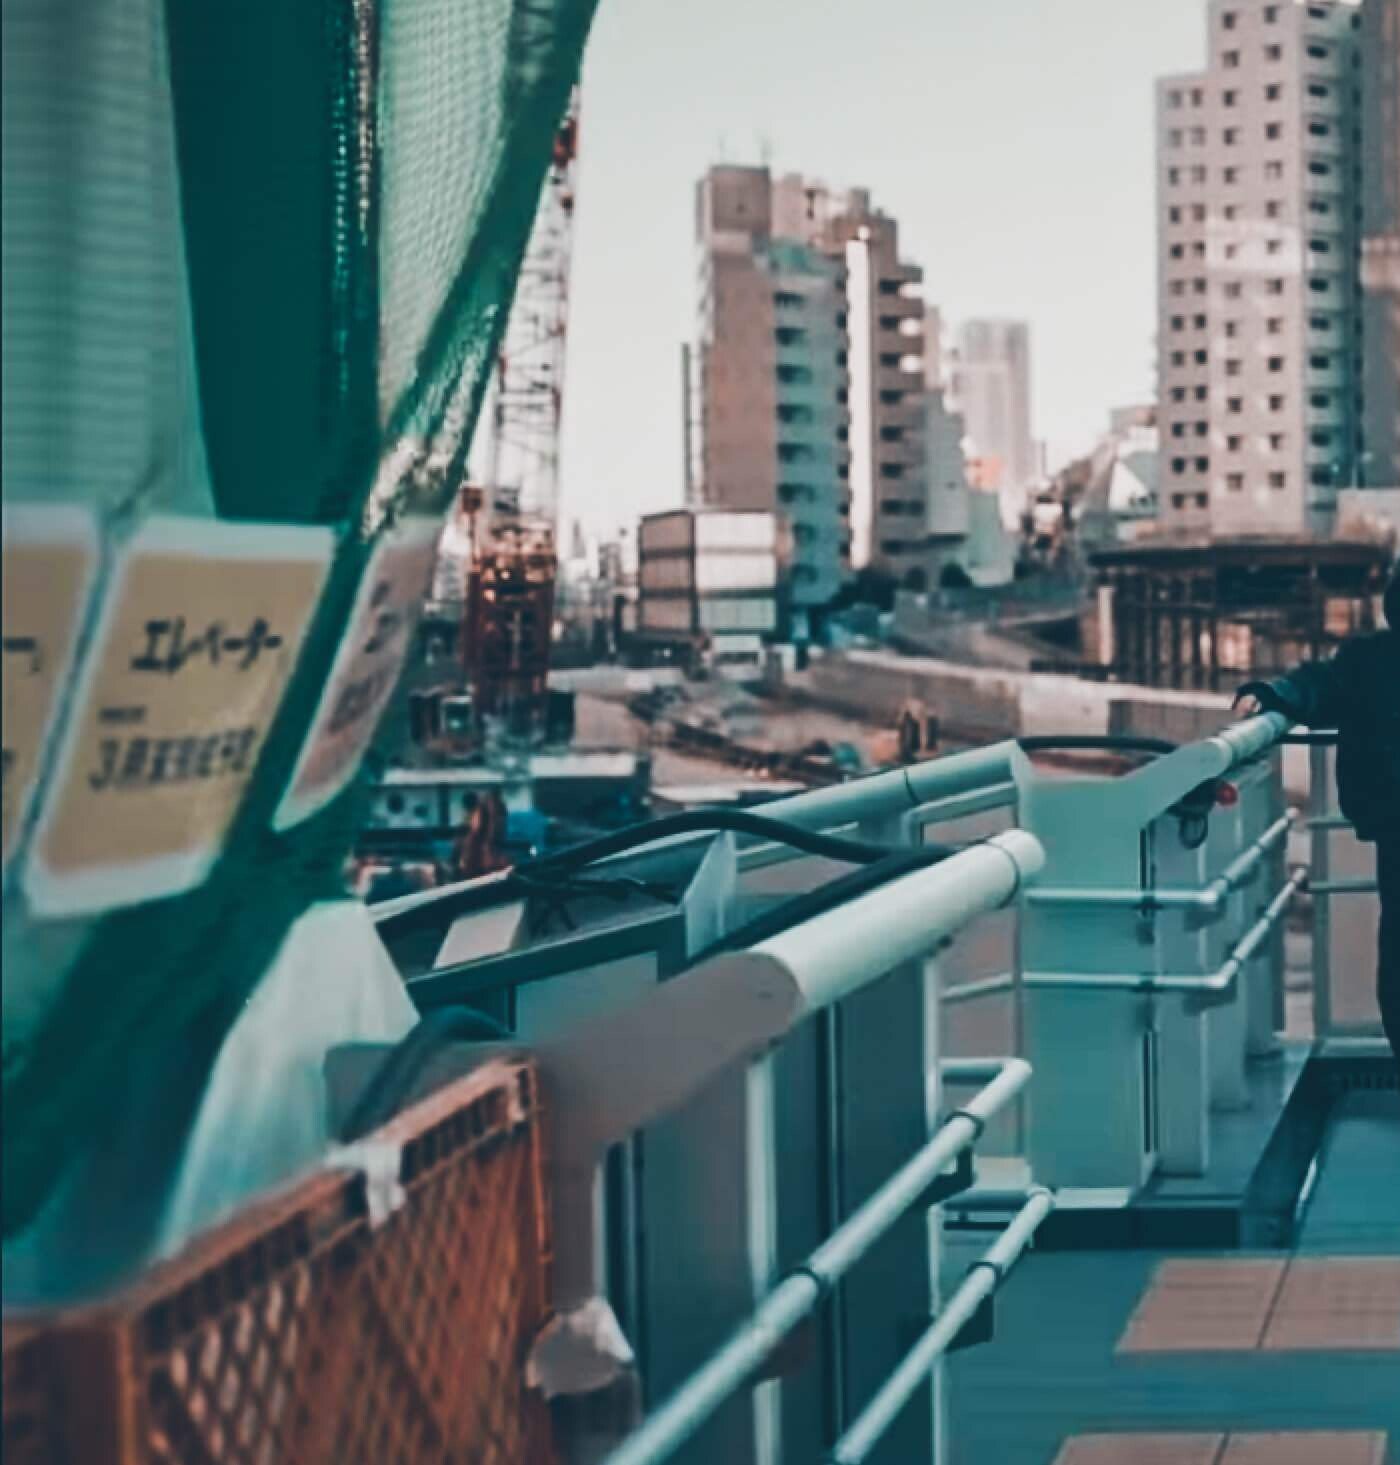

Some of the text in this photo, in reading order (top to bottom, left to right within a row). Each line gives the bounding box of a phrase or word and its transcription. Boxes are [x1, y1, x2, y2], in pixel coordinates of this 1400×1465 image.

[130, 616, 283, 676] エレベーター
